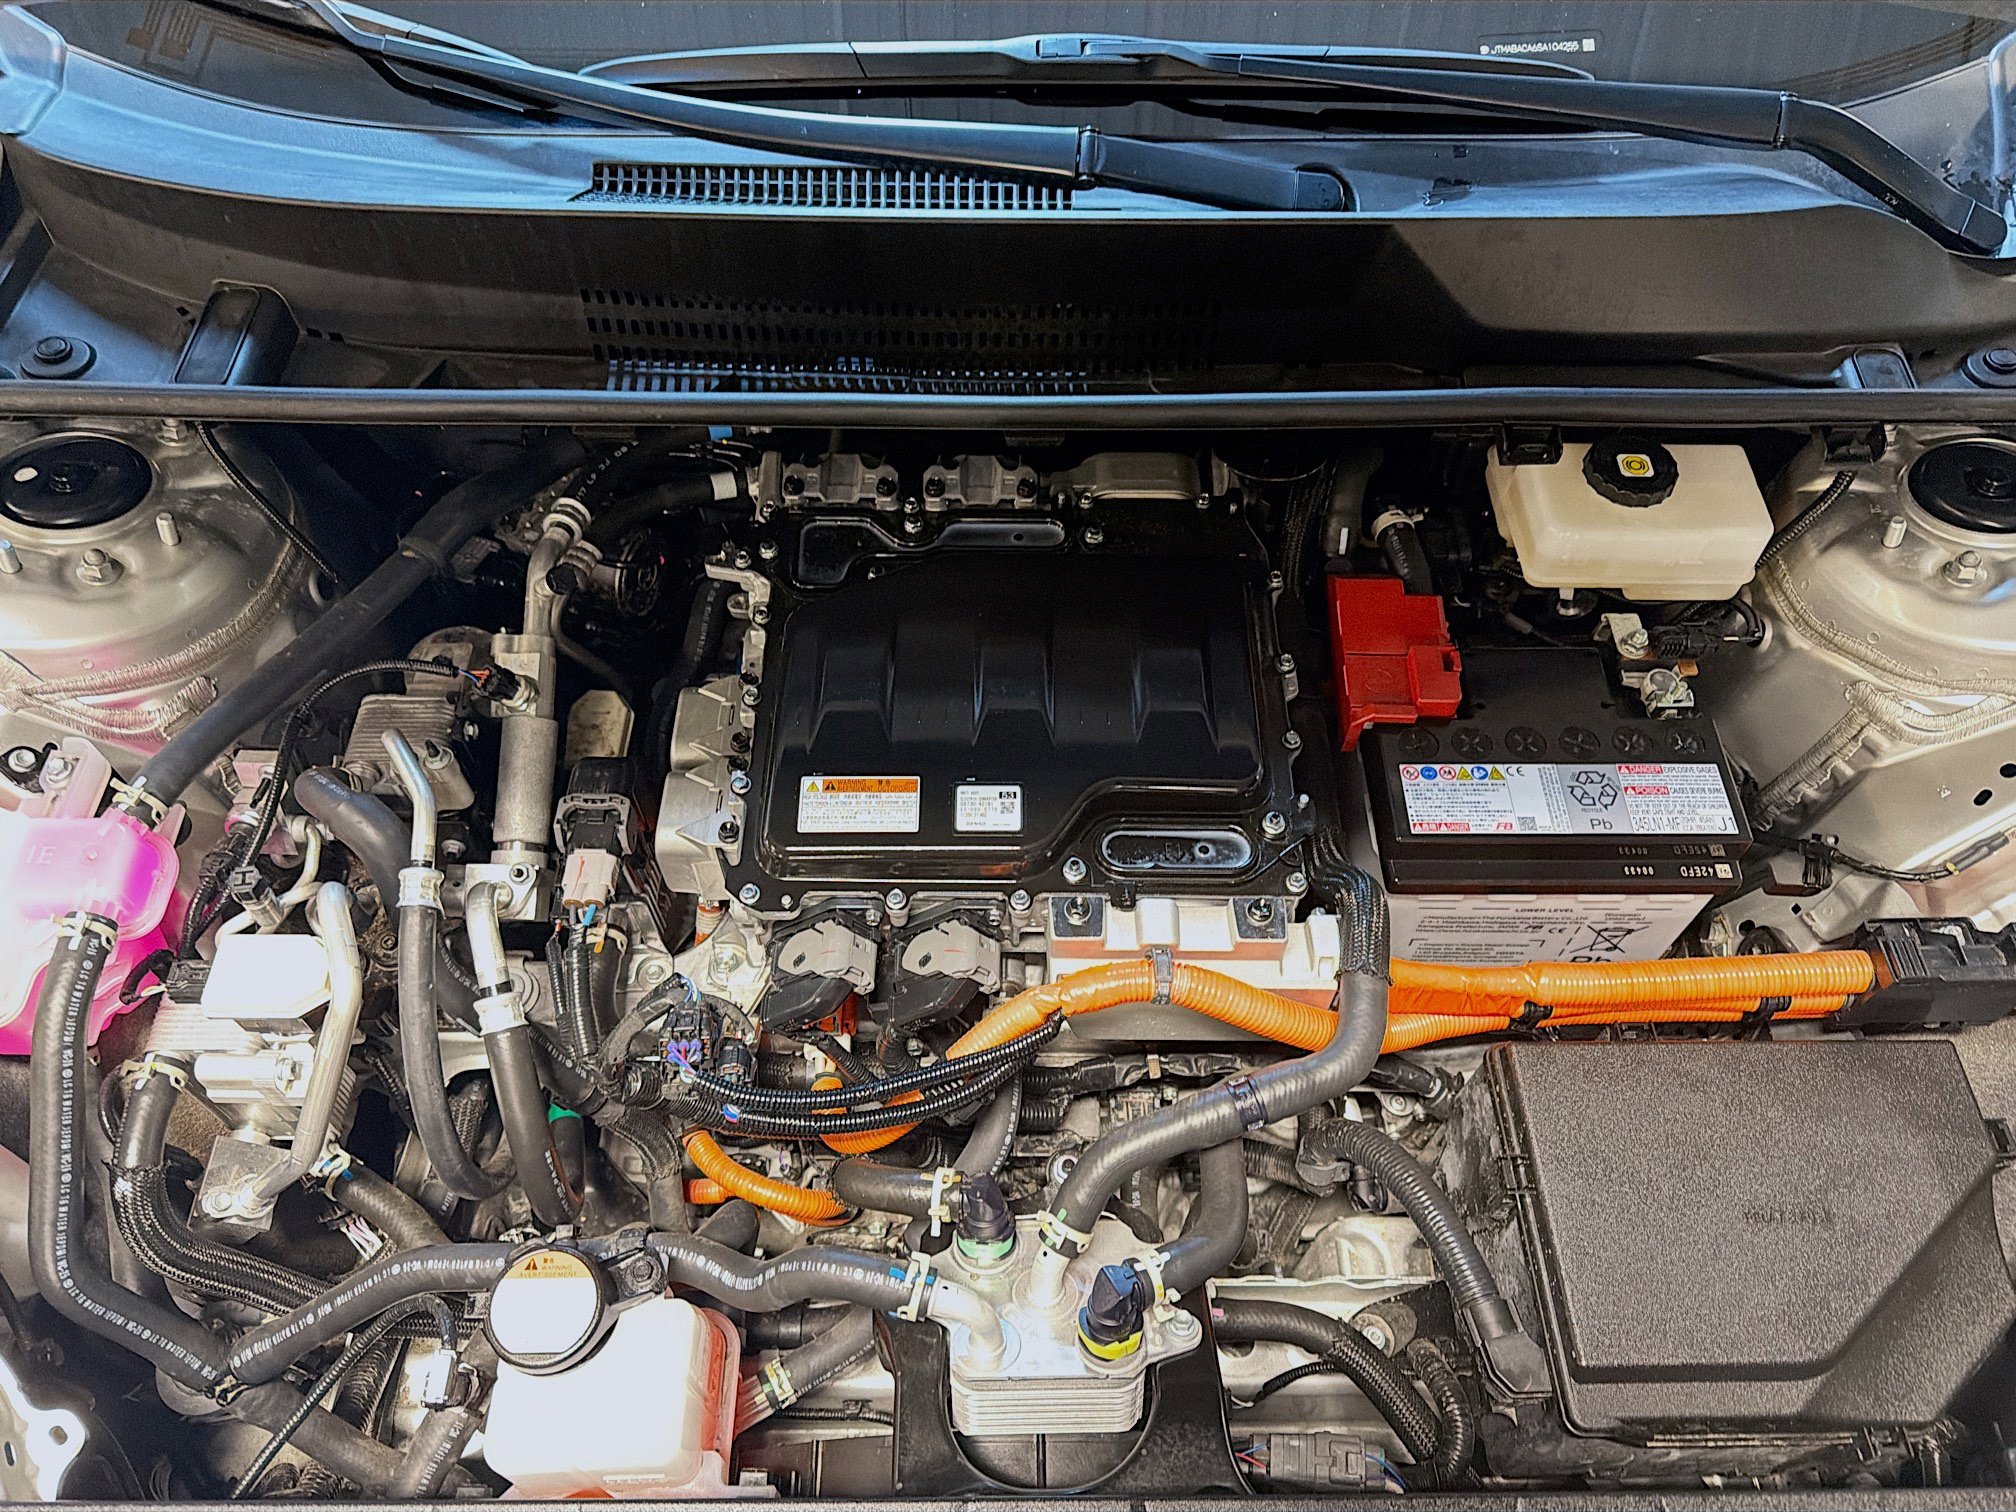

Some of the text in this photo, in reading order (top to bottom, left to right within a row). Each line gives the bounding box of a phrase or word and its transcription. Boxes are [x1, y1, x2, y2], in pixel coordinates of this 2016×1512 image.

[1630, 766, 1717, 774] DANGER EXPLOSIVE GASES
[1636, 786, 1668, 794] POISON
[1590, 818, 1612, 830] Pb
[1680, 866, 1714, 877] 42EFD
